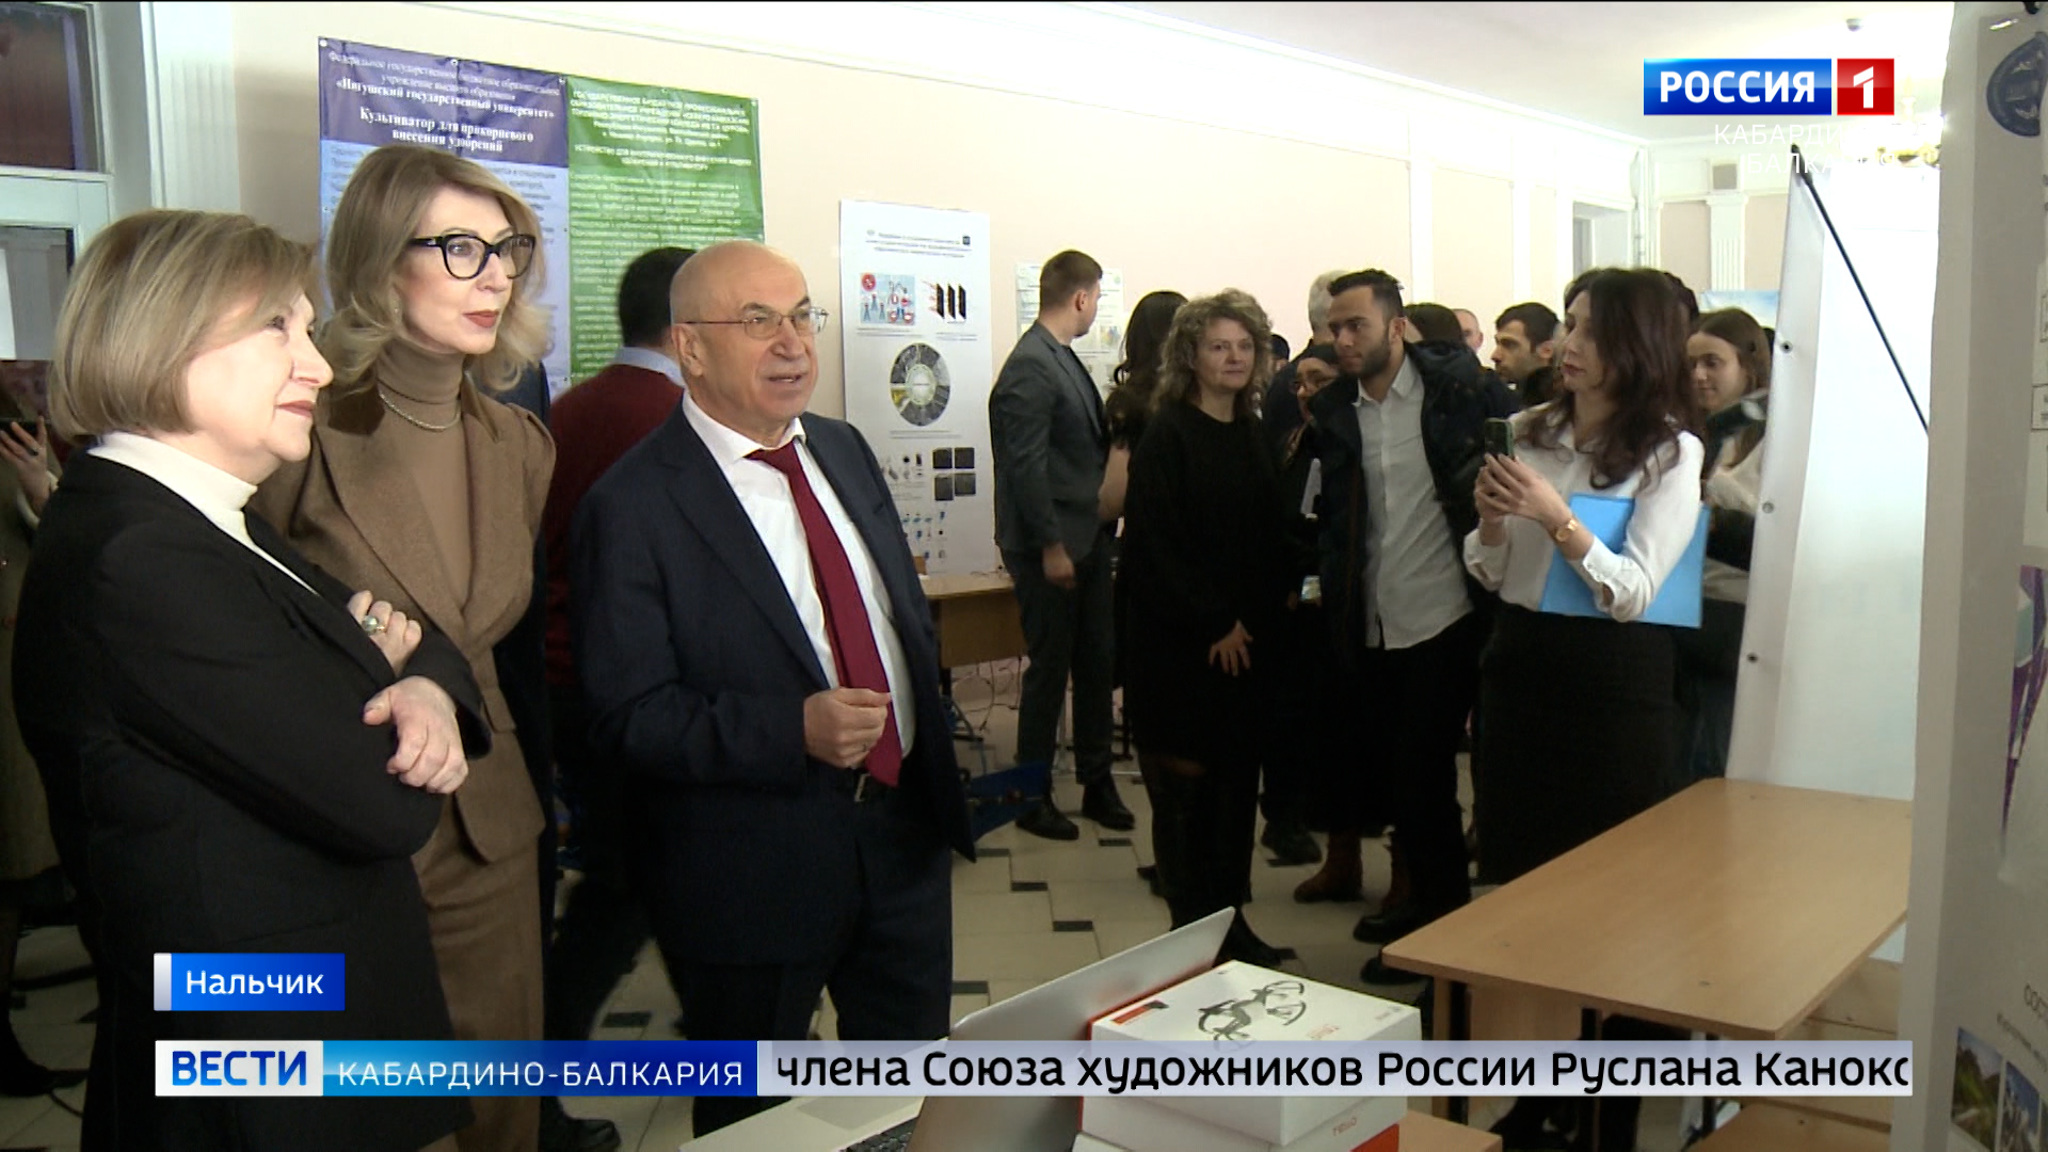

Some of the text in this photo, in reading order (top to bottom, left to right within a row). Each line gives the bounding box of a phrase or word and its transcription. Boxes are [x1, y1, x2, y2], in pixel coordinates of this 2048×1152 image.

[360, 106, 534, 143] Культиватор для прикорневого
[392, 129, 503, 152] внесения удобрений
